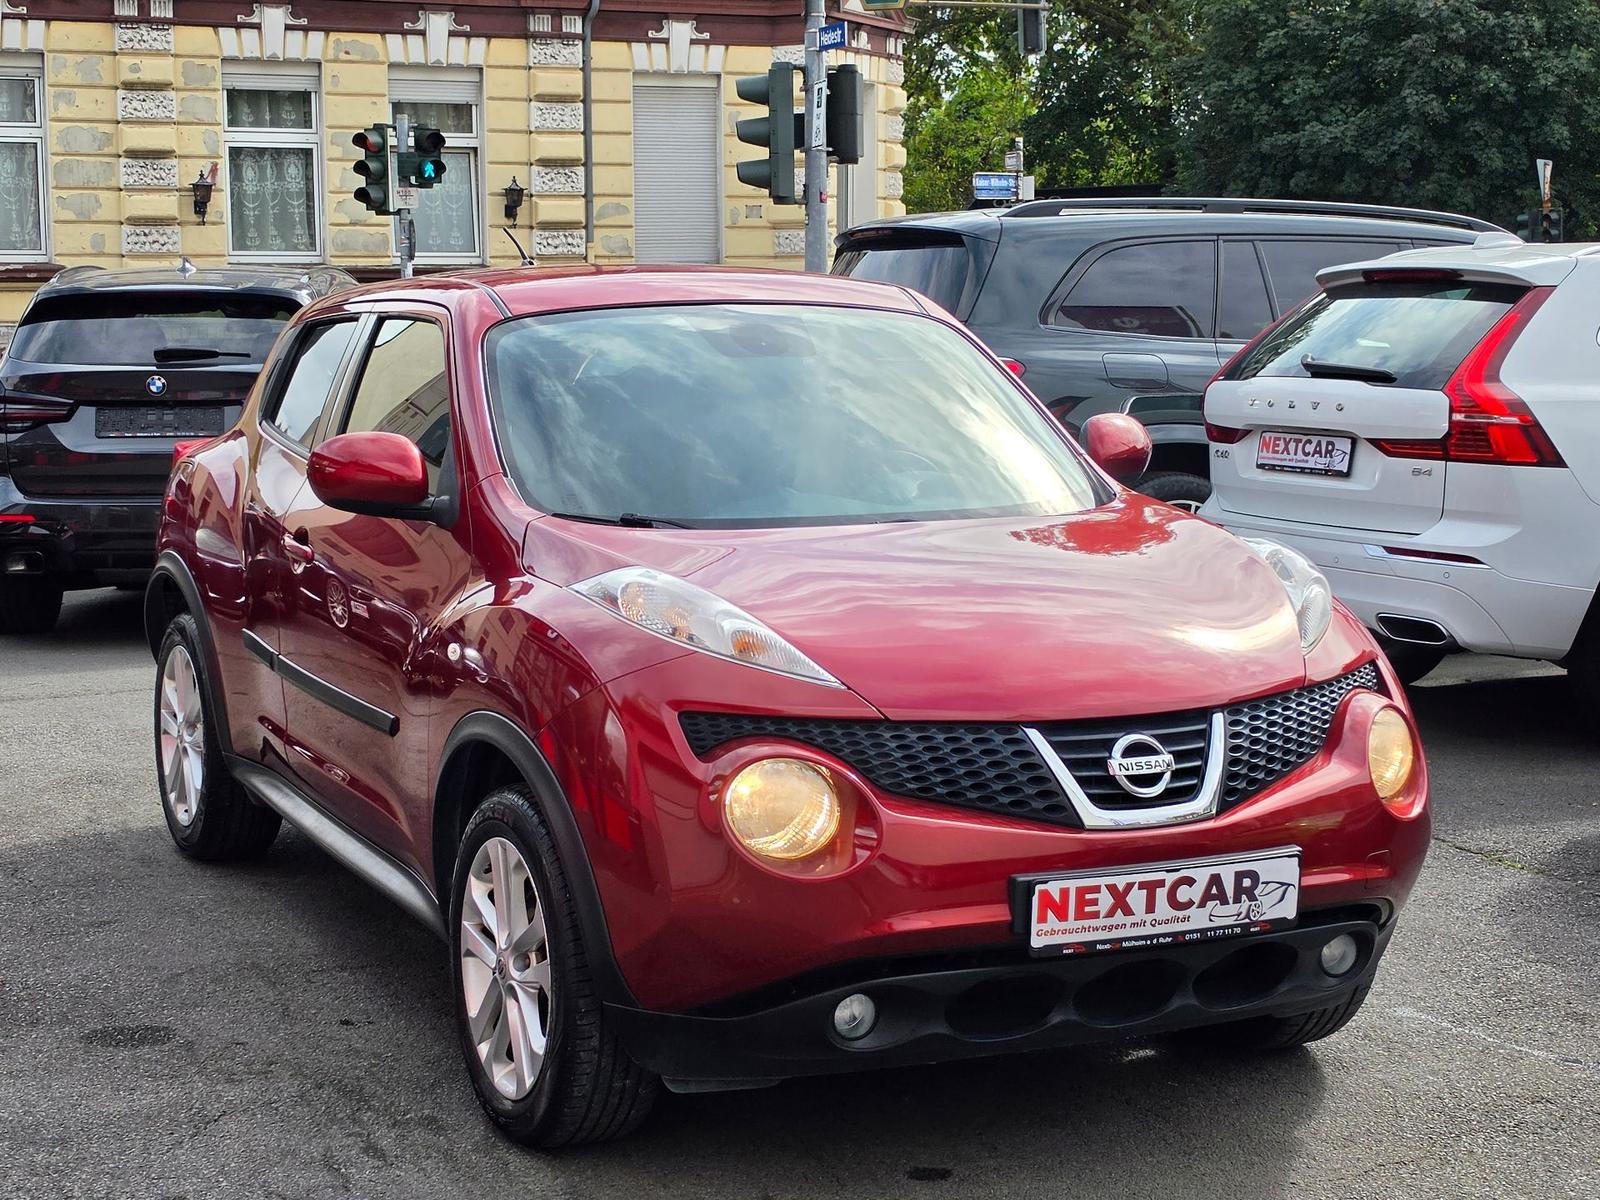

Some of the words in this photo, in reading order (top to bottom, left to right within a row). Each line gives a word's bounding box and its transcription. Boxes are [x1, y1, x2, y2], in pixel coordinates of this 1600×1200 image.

[820, 27, 844, 47] Heidestr.
[1260, 435, 1336, 459] NEXTCAR
[1411, 467, 1433, 477] B4
[1118, 759, 1171, 772] NISSAN
[1036, 869, 1261, 925] NEXTCAR
[1036, 921, 1127, 938] Gebrauchtwagen
[1129, 919, 1147, 929] mit
[1149, 914, 1191, 926] Qualität
